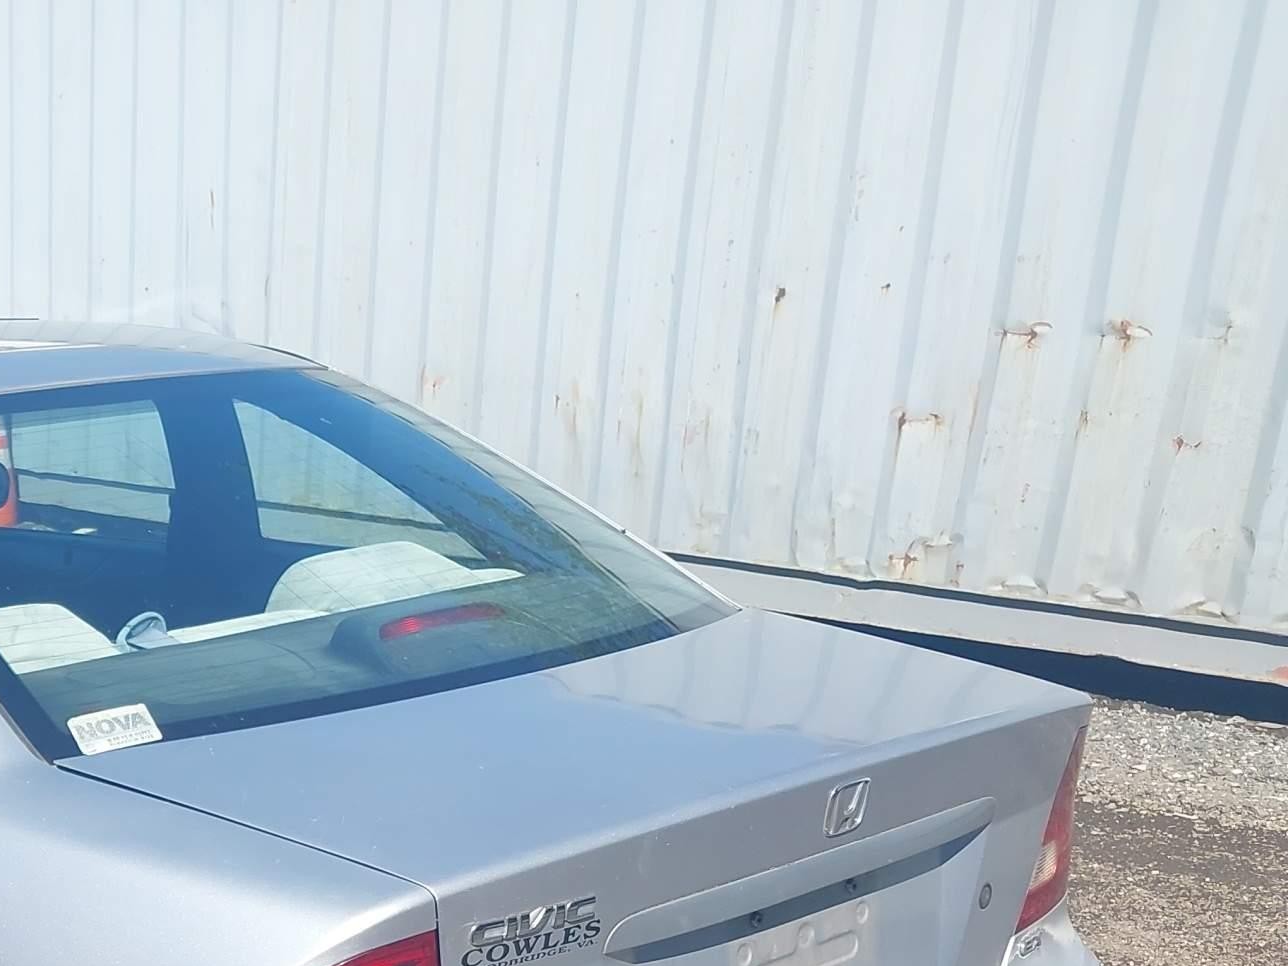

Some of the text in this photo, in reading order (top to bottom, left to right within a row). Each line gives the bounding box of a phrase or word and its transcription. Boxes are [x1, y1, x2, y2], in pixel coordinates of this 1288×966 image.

[74, 713, 151, 740] NOVA
[461, 919, 601, 966] COWLES
[471, 896, 597, 948] CIVIC
